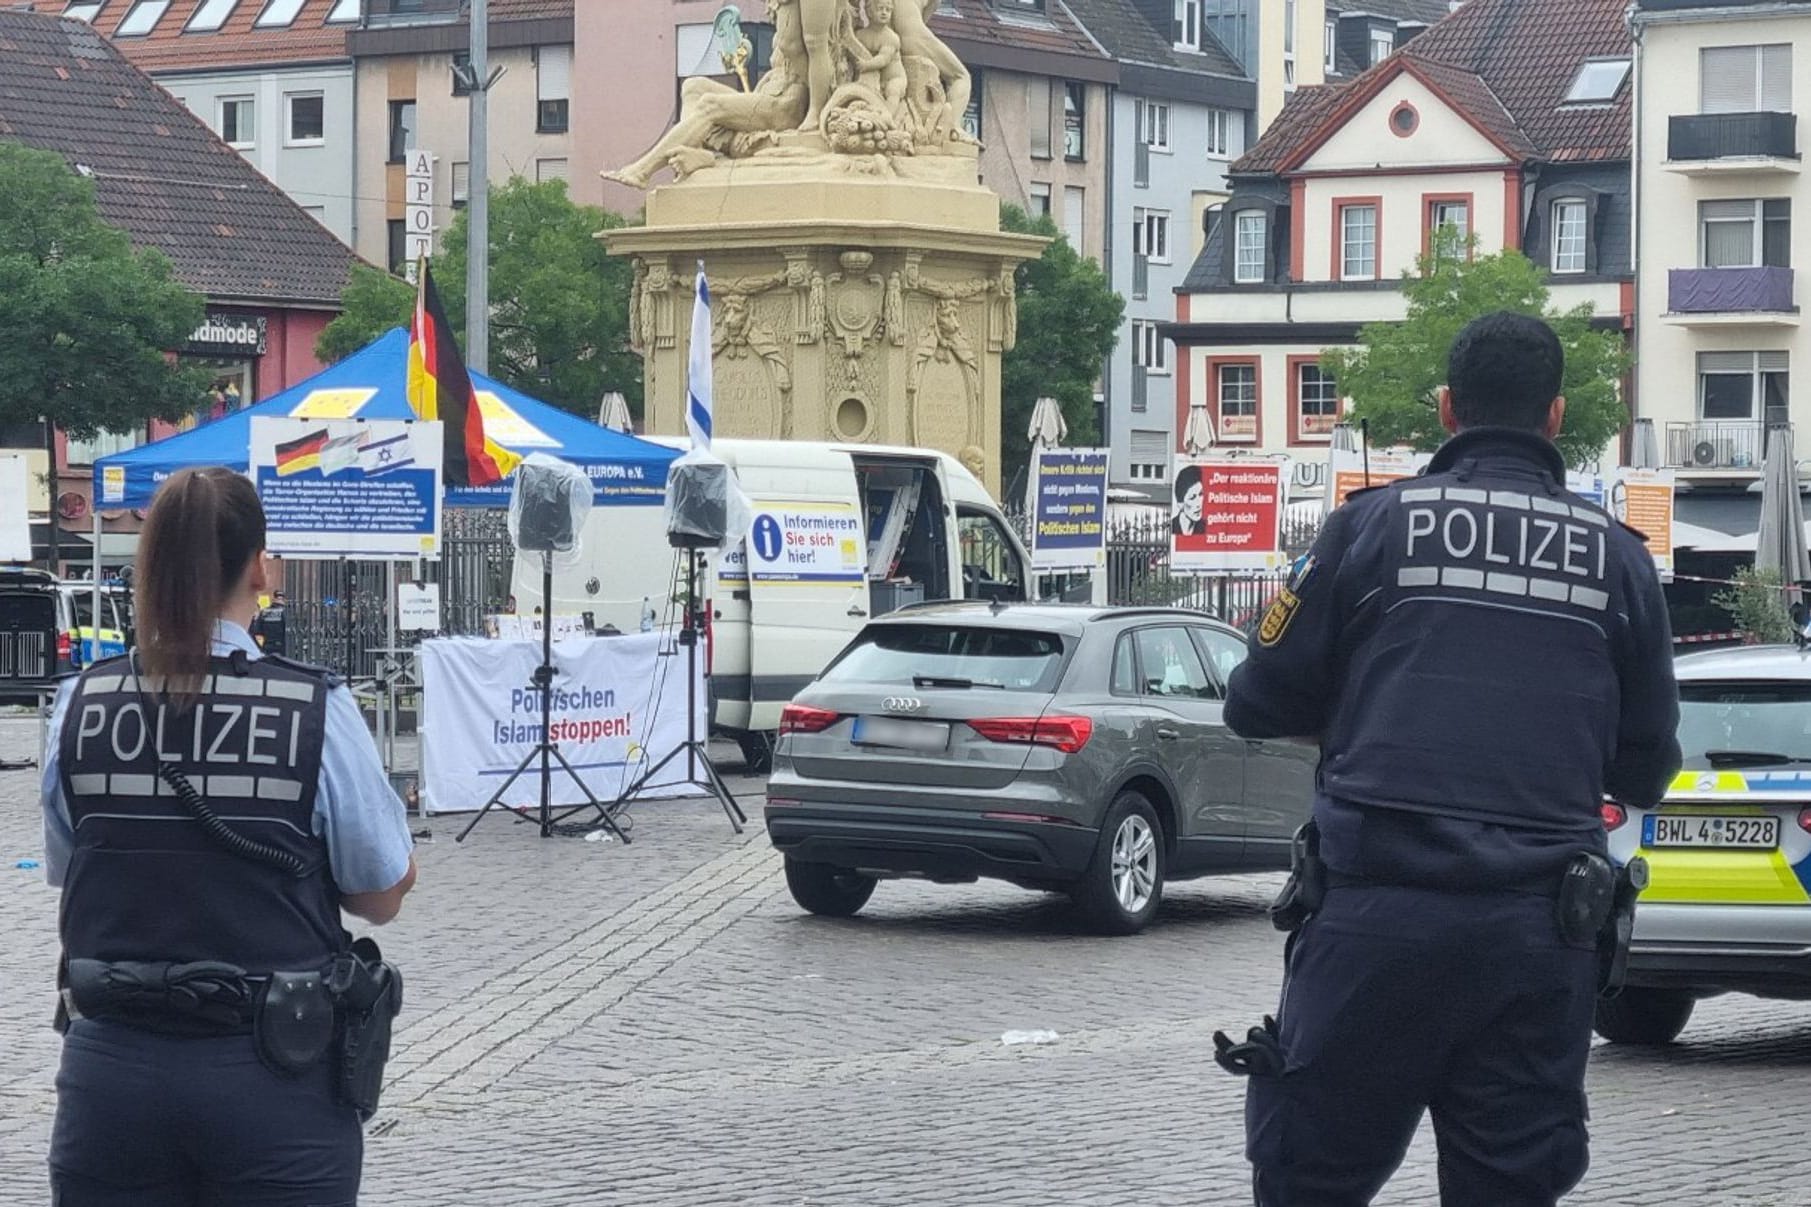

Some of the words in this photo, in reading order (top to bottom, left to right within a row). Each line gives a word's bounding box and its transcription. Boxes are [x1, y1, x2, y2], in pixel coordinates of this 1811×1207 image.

[588, 466, 626, 479] EUROPA
[1230, 473, 1277, 485] reaktionäre
[1208, 492, 1249, 504] Politische
[1250, 492, 1273, 504] Islam
[784, 514, 858, 530] Informieren
[1207, 512, 1235, 526] gehört
[1236, 513, 1258, 524] nicht
[1039, 521, 1080, 535] Politischen
[1081, 521, 1101, 535] Islam
[785, 532, 805, 545] Sie
[809, 532, 834, 547] sich
[1206, 535, 1217, 544] zu
[1407, 507, 1606, 580] POLIZEI
[787, 549, 816, 563] hier!
[76, 702, 300, 767] POLIZEI
[494, 718, 546, 745] Islam
[549, 711, 631, 745] stoppen!
[1657, 819, 1693, 842] BWL
[1698, 820, 1709, 842] 4
[1725, 821, 1774, 844] 5228
